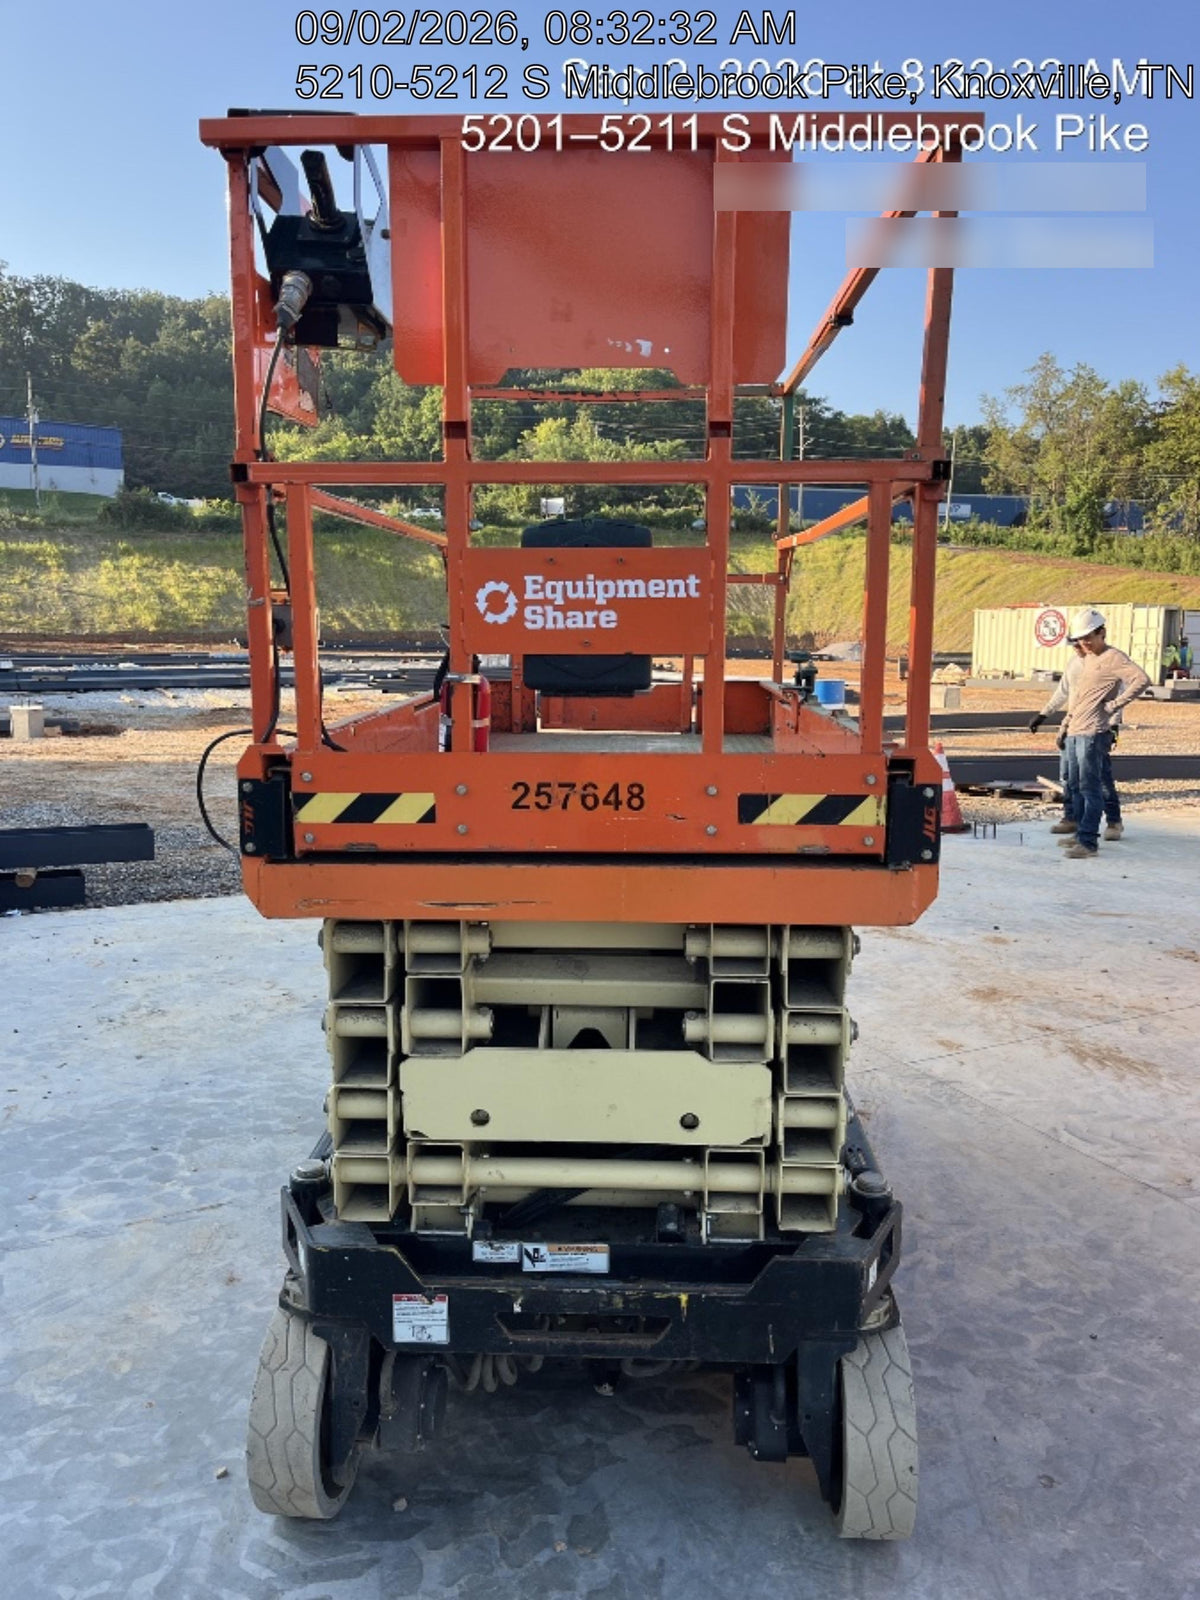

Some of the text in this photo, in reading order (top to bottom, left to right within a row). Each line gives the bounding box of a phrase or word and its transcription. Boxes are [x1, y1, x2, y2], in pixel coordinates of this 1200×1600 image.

[523, 573, 701, 605] Equipment
[523, 605, 619, 630] Share
[510, 781, 646, 811] 257648
[922, 805, 937, 843] JLG
